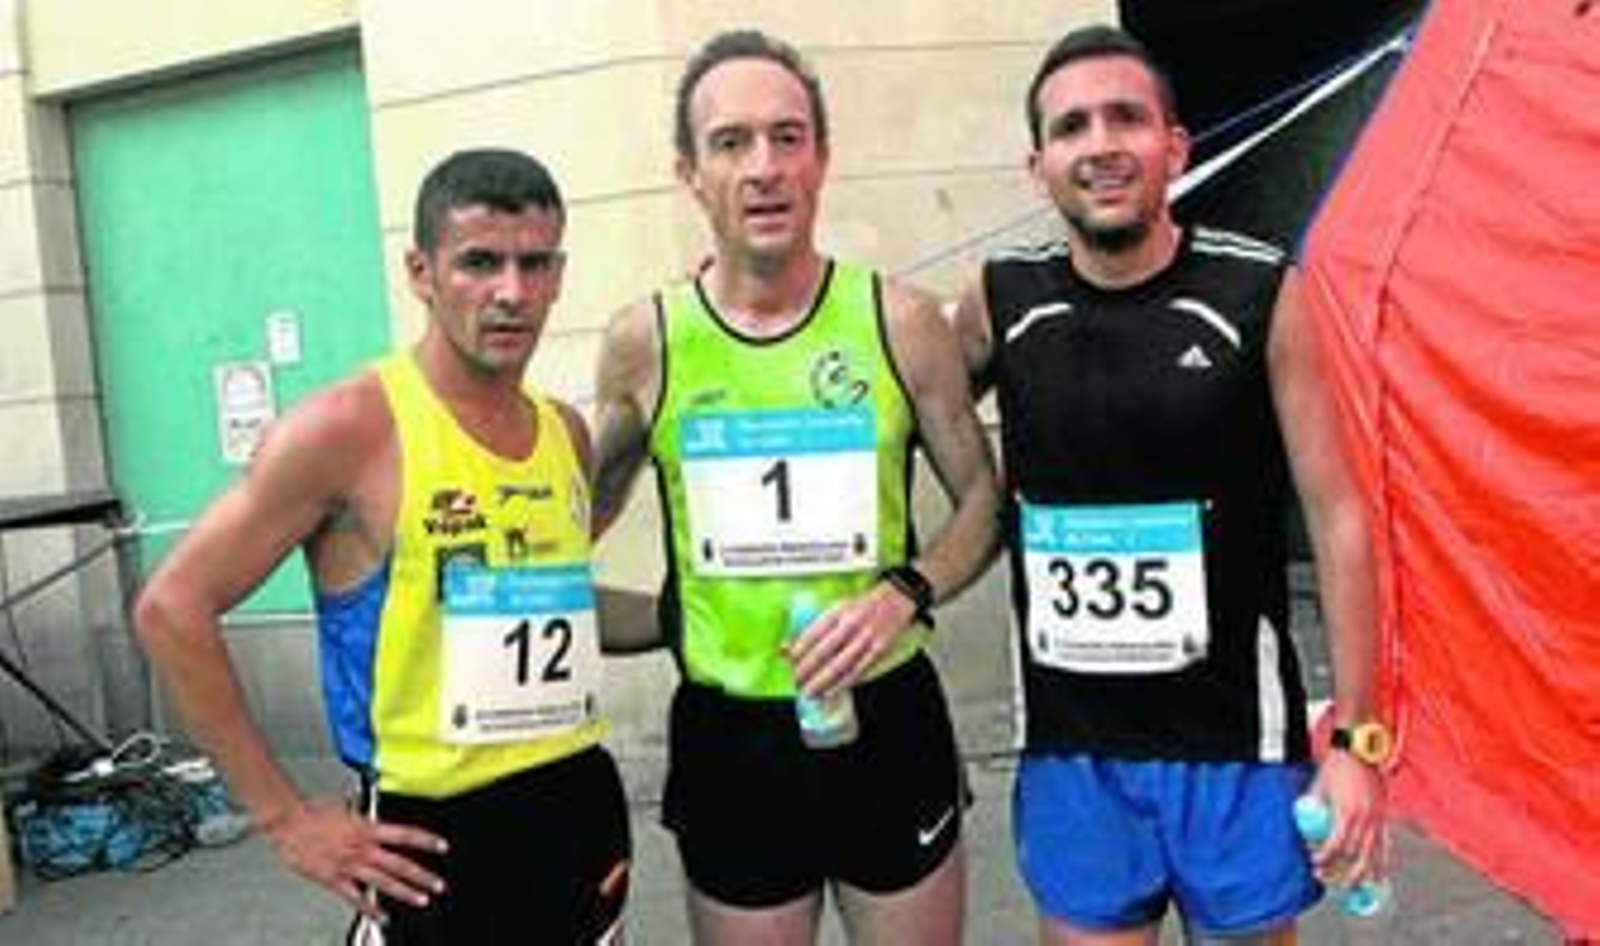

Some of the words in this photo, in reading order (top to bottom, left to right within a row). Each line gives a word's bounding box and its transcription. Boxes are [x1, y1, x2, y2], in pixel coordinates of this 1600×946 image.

[762, 459, 791, 522] 1
[1048, 558, 1172, 619] 335
[504, 618, 572, 686] 12
